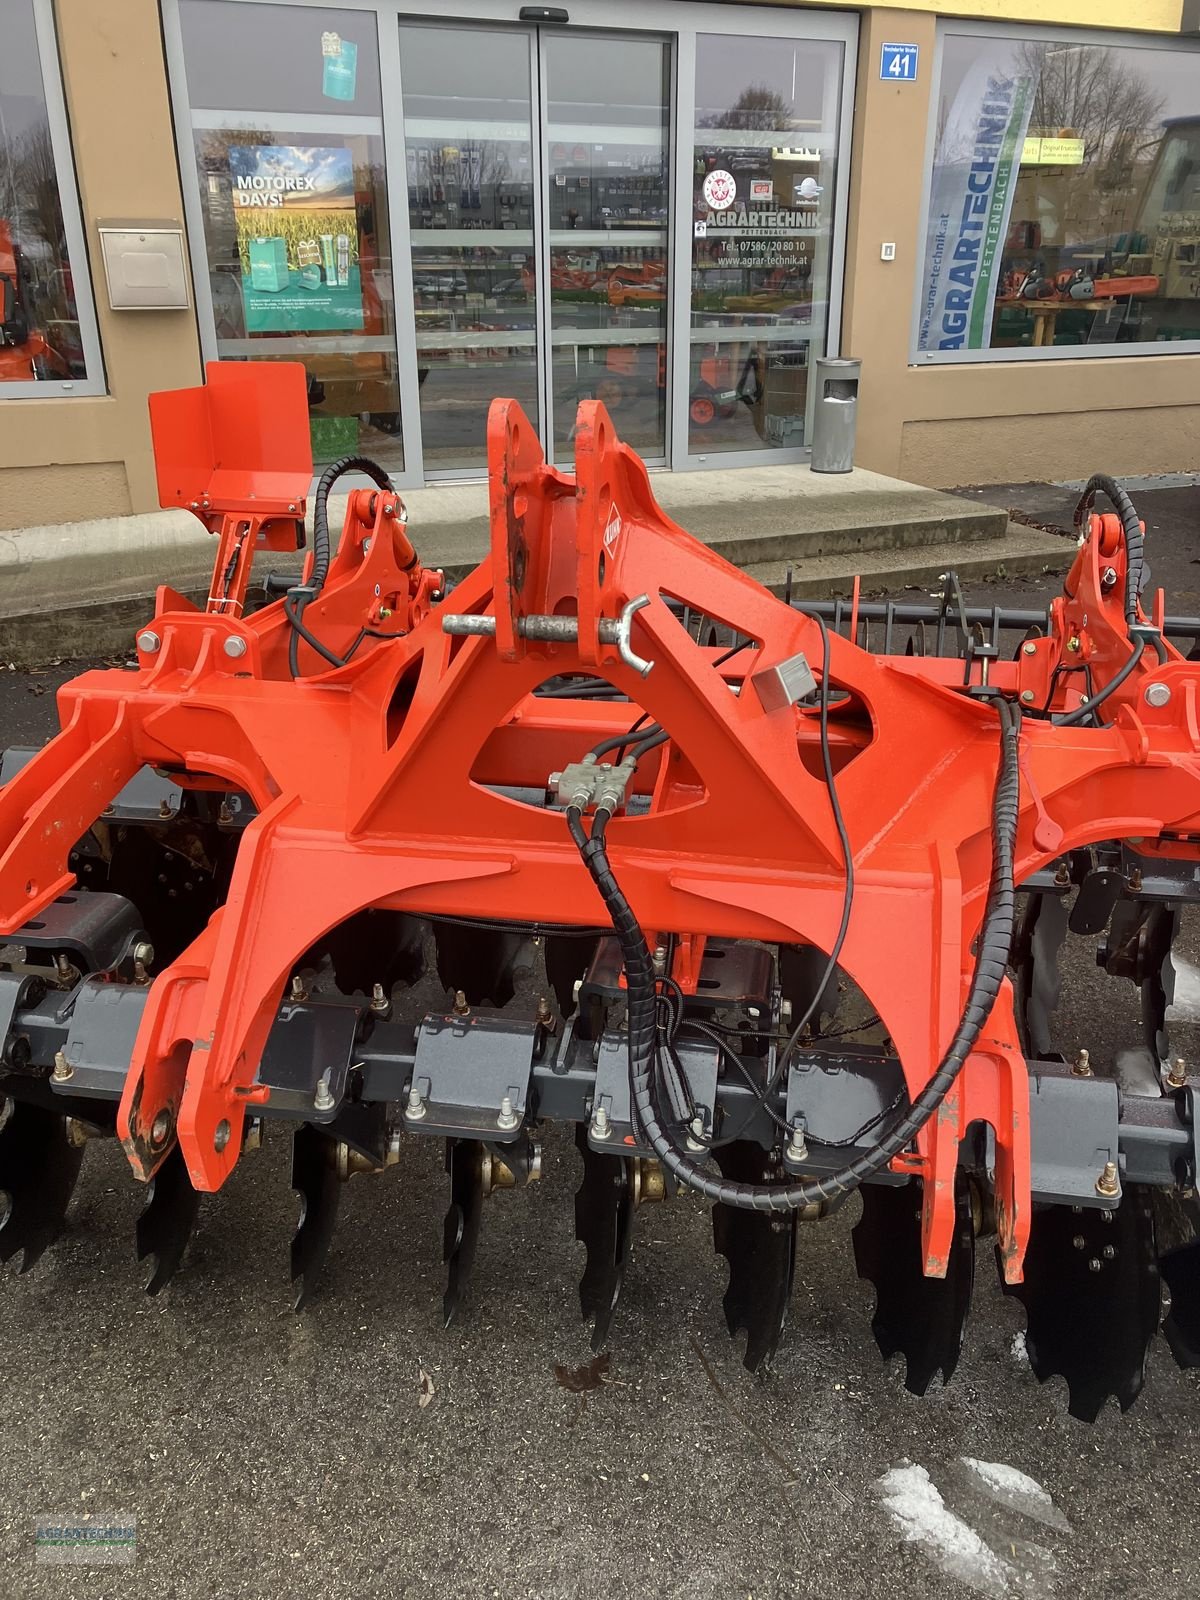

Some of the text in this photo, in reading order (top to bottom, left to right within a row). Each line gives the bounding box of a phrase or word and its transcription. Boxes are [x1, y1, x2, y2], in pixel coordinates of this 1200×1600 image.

[889, 53, 910, 77] 41
[237, 175, 316, 191] MOTOREX
[239, 192, 284, 207] DAYS!
[706, 210, 822, 228] AGRARTECHNIK
[938, 76, 1014, 350] AGRARTECHNIK
[980, 167, 1009, 277] PETTENBACH
[721, 241, 739, 252] Tel.:
[783, 241, 794, 252] 80
[795, 241, 806, 252] 10
[717, 256, 808, 268] www.agrar-technik.at
[919, 212, 950, 350] www.agrar-technik.at
